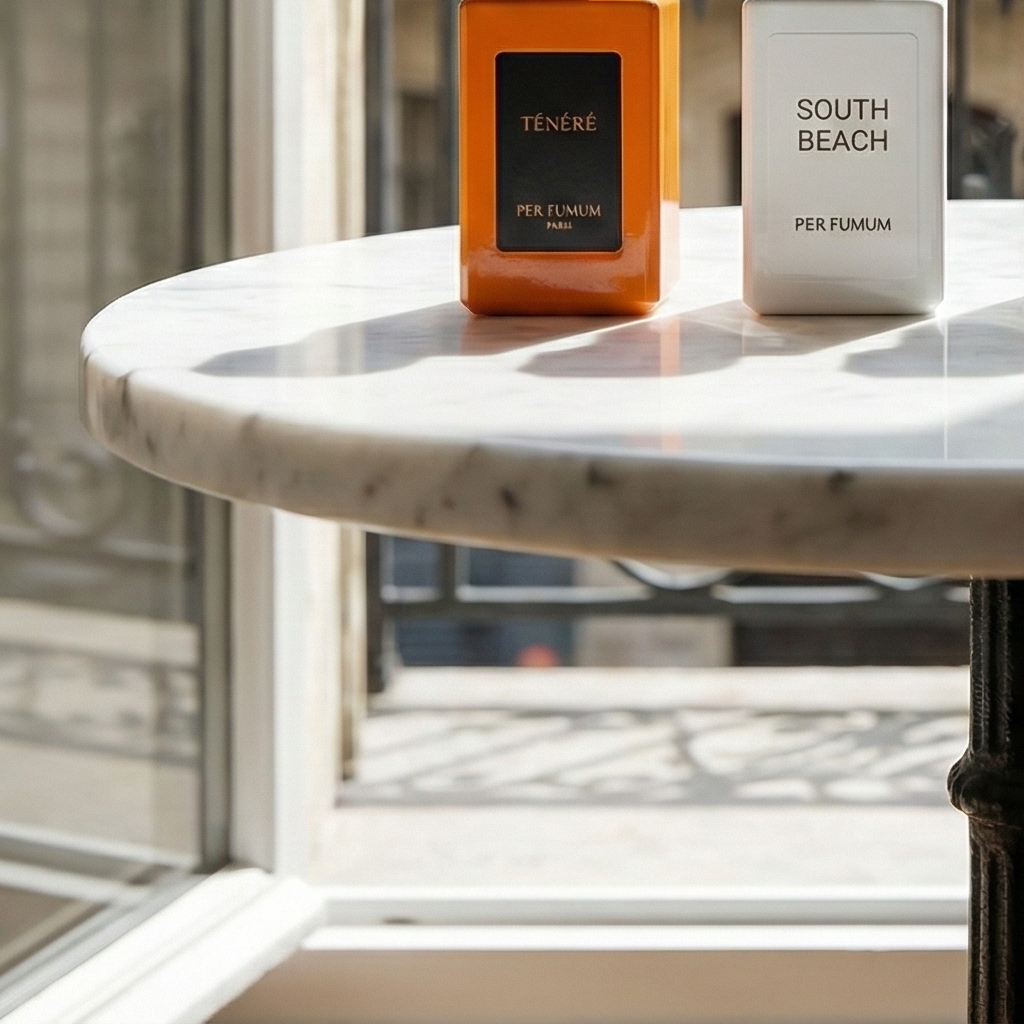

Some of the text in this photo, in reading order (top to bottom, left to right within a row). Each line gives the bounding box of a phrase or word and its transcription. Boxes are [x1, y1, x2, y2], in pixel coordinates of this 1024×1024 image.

[796, 98, 889, 120] SOUTH
[520, 111, 597, 132] TÉNÉRÉ
[798, 129, 888, 151] BEACH
[517, 204, 544, 217] PER
[795, 217, 892, 231] PER FUMUM
